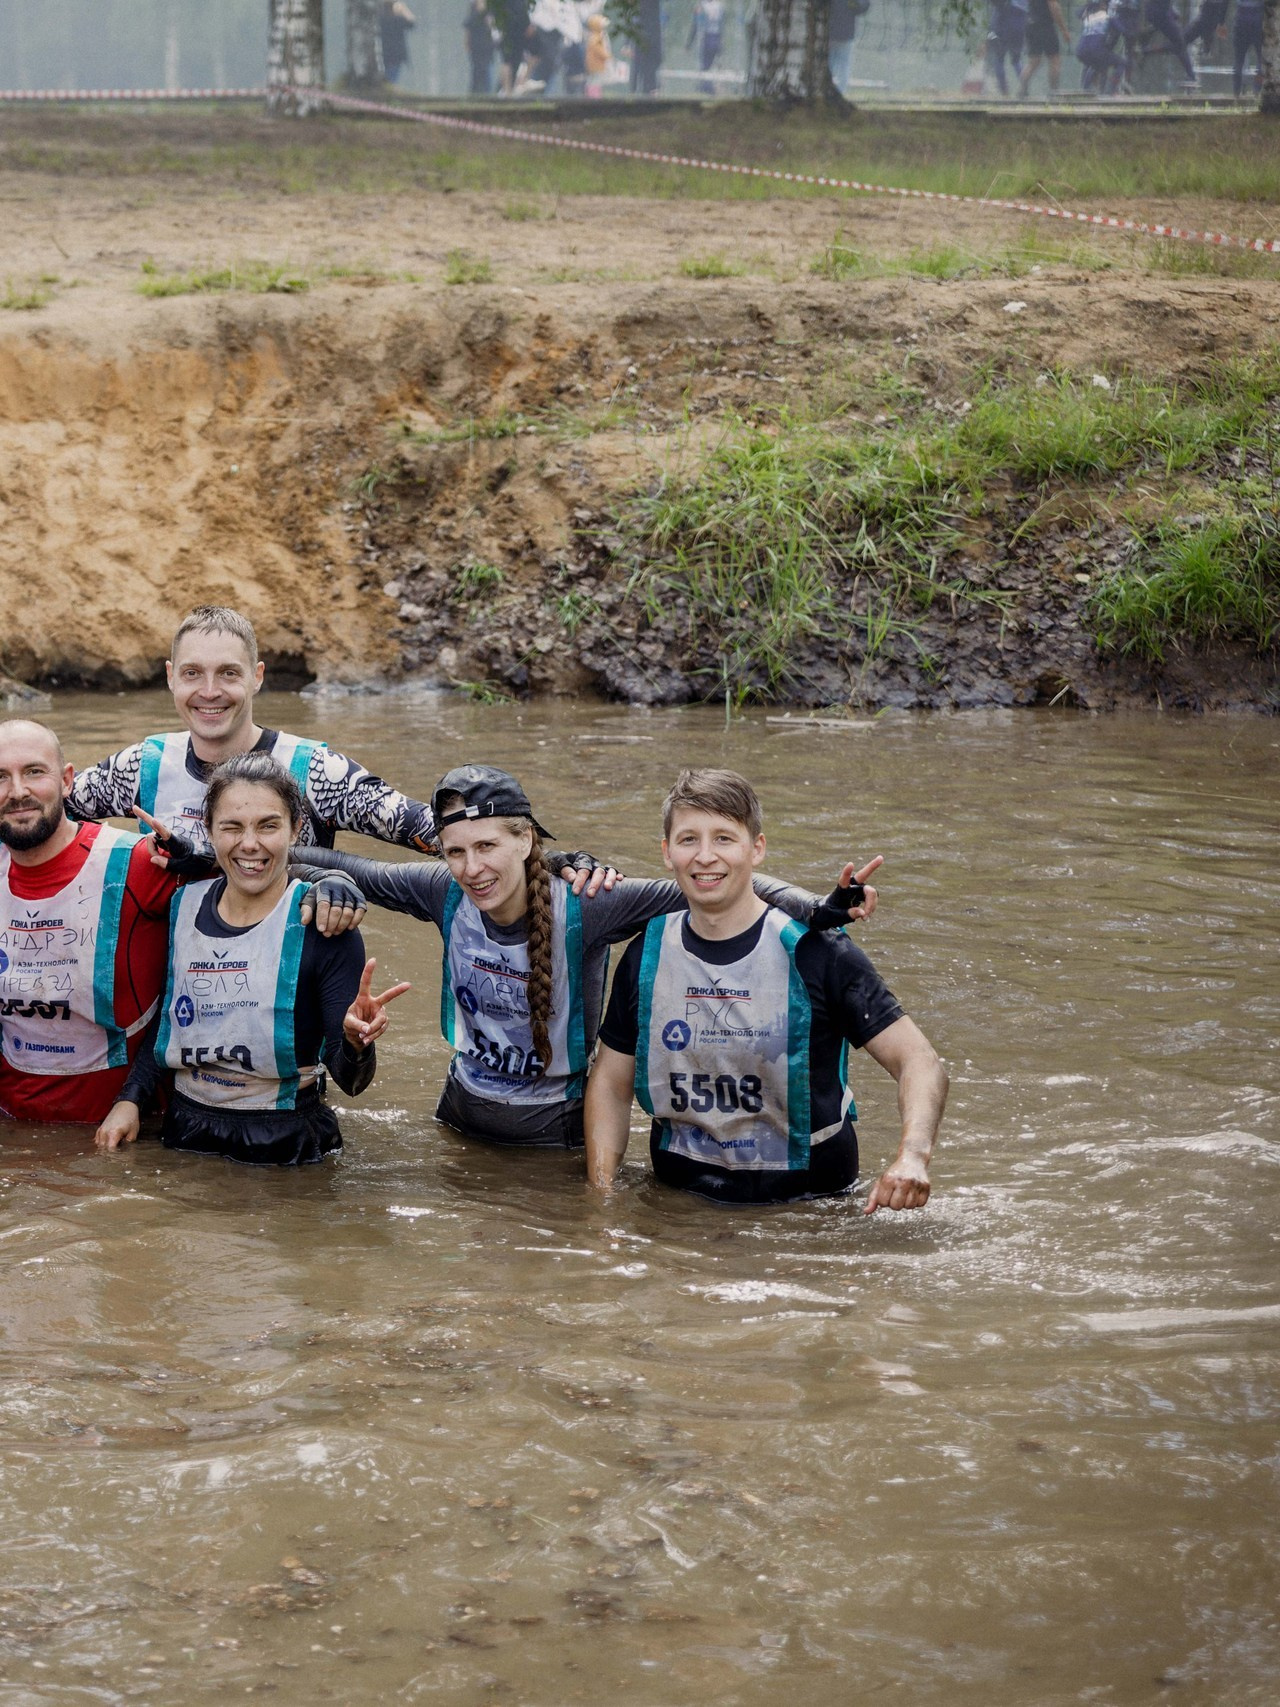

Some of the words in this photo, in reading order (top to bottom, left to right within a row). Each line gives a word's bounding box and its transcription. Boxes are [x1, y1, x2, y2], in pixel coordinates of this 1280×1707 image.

[183, 807, 204, 818] ГОНК
[30, 919, 64, 929] ГЕРОЕВ
[17, 959, 79, 968] АЭМ-ТЕХНОЛОГИИ
[189, 962, 216, 970] ГОНКА
[217, 961, 249, 970] ГЕРОЕВ
[474, 956, 502, 972] ГОНКА
[466, 971, 526, 1003] АЛЁН
[686, 987, 715, 996] ГОНКА
[715, 987, 750, 997] ГЕРОЕВ
[201, 1000, 259, 1010] АЭМ-ТЕХНОЛОГИИ
[685, 1000, 754, 1030] РУС
[700, 1029, 770, 1038] АЭМ-ТЕХНОЛОГИИ
[25, 1042, 76, 1053] ГАЗПРОМБАНК
[670, 1072, 763, 1113] 5508
